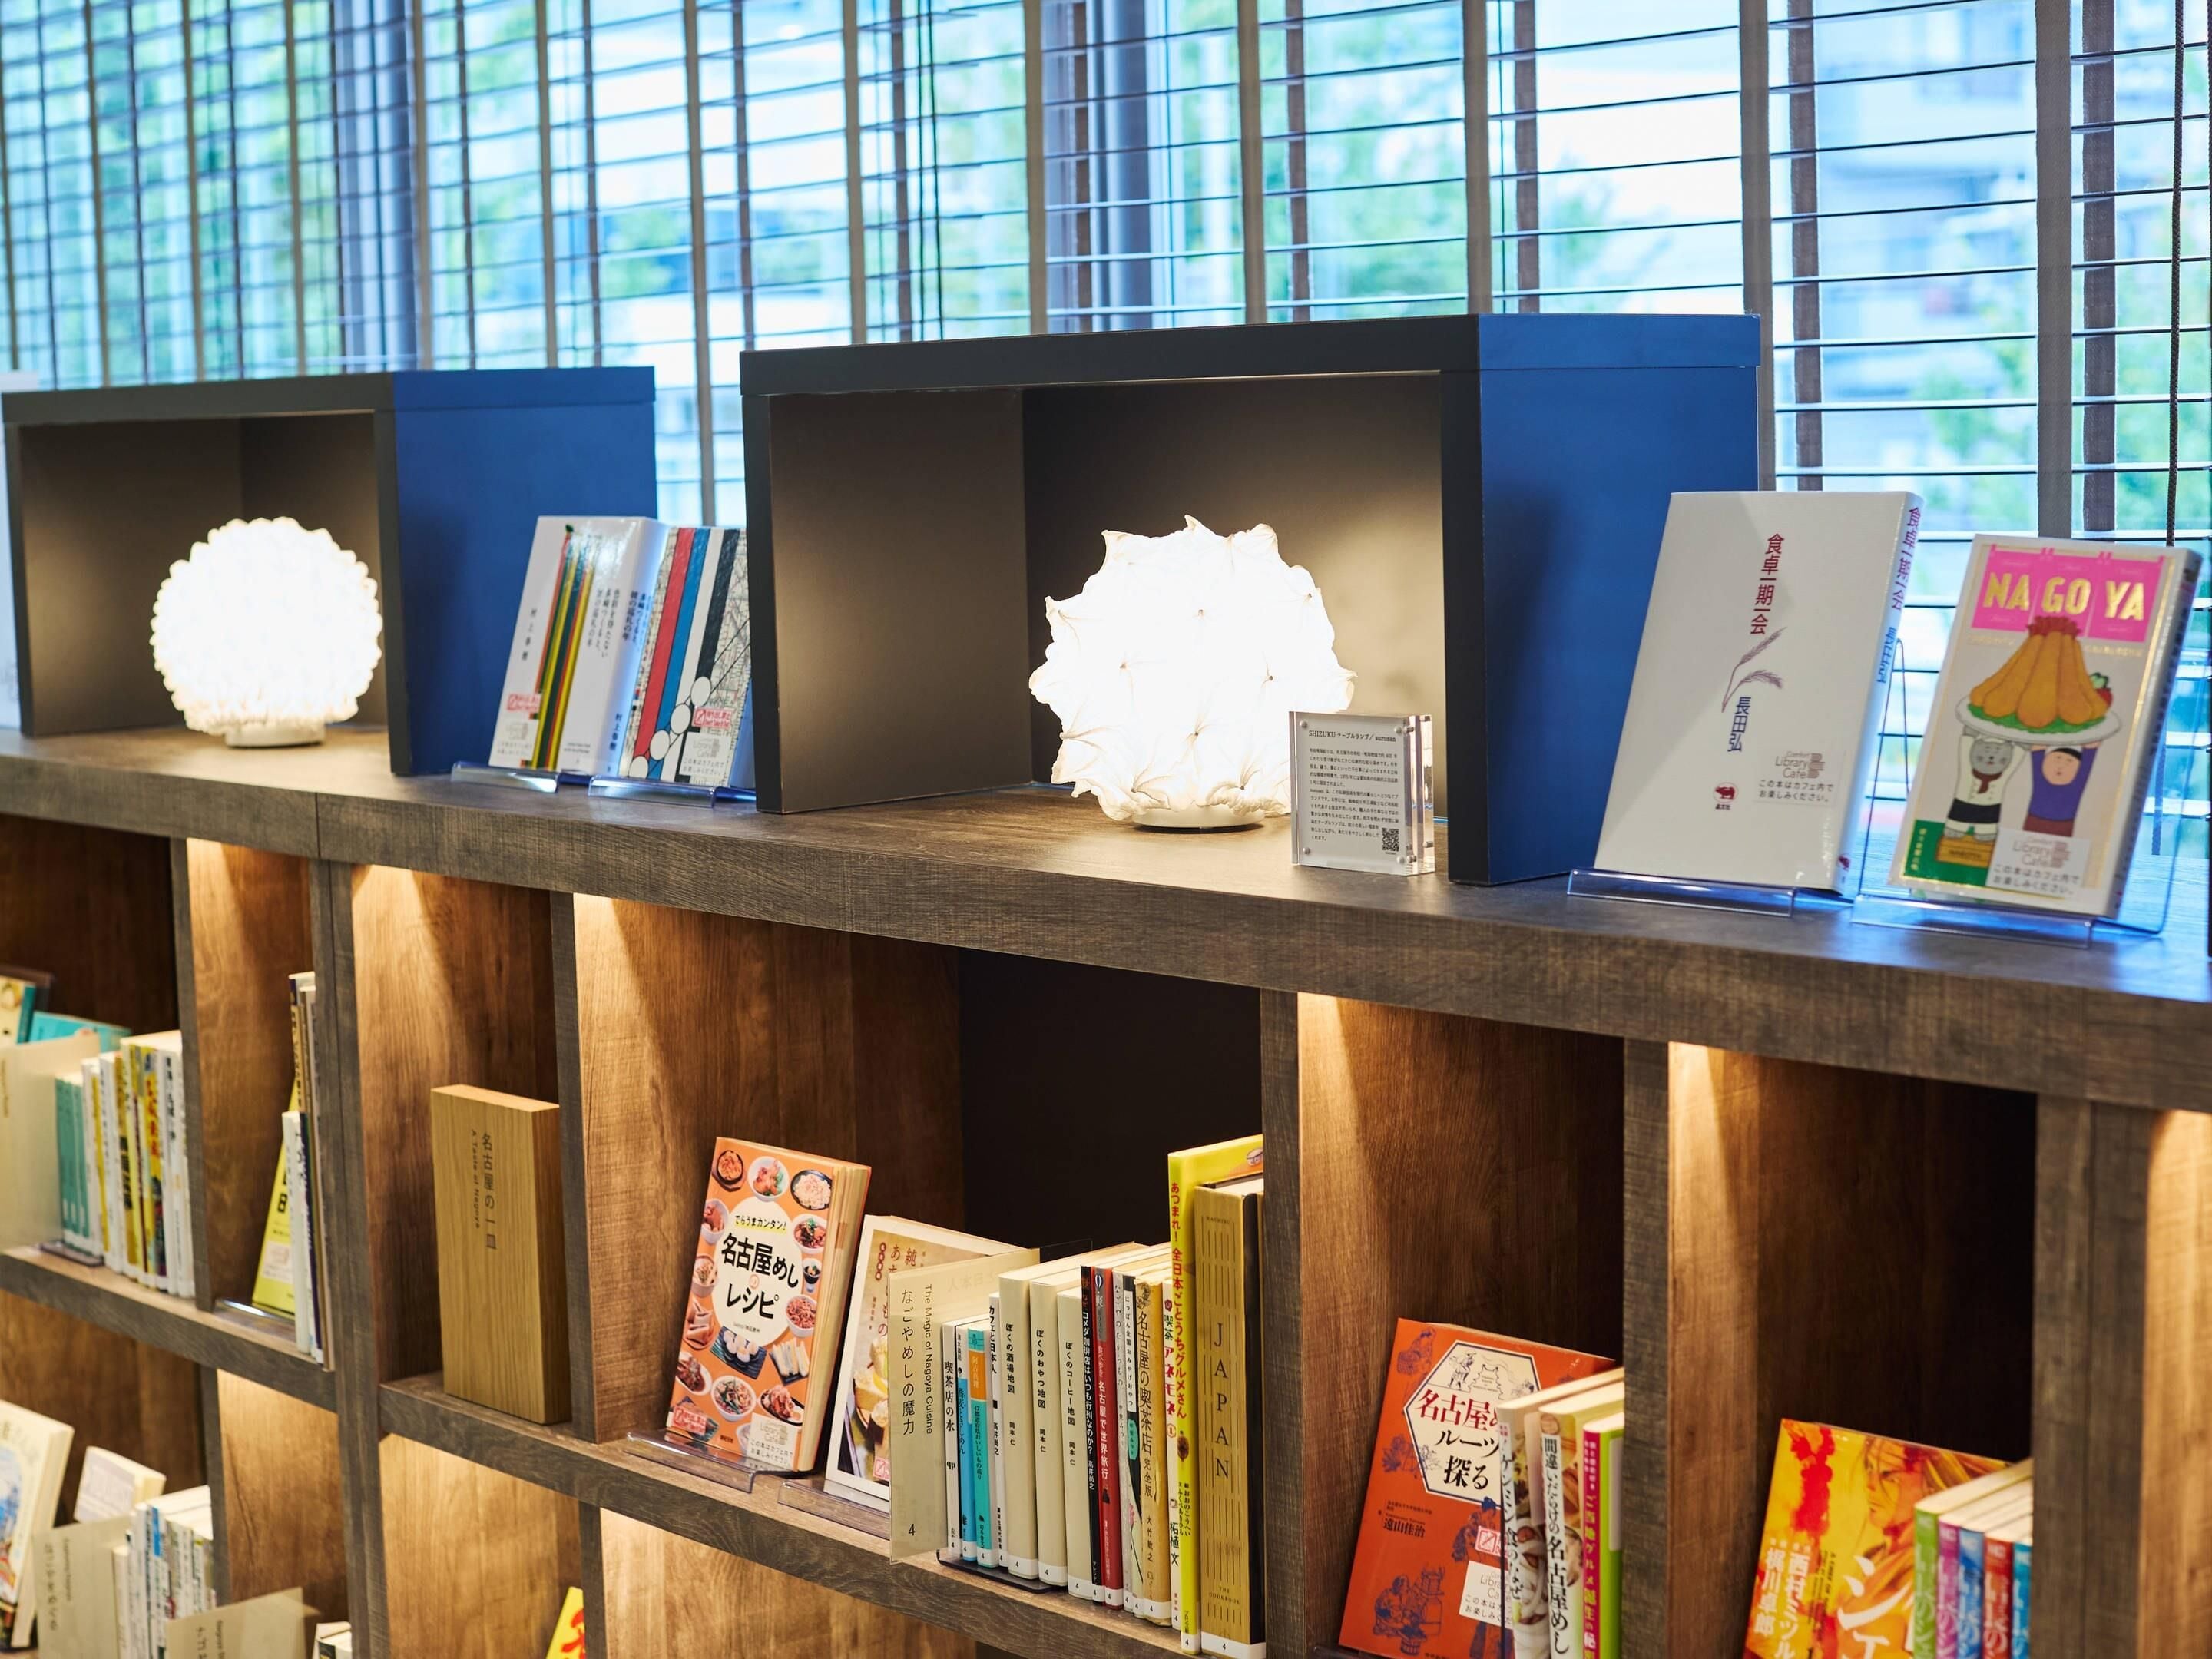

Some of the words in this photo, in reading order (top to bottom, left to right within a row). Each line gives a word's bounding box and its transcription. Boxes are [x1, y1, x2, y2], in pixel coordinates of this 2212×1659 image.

[1750, 533, 1785, 635] 食卓一期一会
[1892, 507, 1921, 611] 食卓一期一会
[1982, 572, 2030, 611] NA
[2041, 576, 2091, 615] GO
[2104, 580, 2145, 621] YA
[1726, 697, 1752, 753] 長田弘
[1758, 780, 1834, 792] この本はカフェ内で
[1775, 756, 1808, 770] Library
[1758, 790, 1830, 803] お楽しみください。
[1993, 864, 2080, 885] この本はカフェ内で
[1171, 1182, 1181, 1242] あつまれ!
[721, 1233, 799, 1288] 名古屋めし
[727, 1283, 780, 1320] レシピ
[923, 1307, 932, 1338] Magic
[925, 1341, 933, 1351] of
[989, 1306, 998, 1374] カフェと日本人
[1005, 1323, 1015, 1394] ぼくの酒場地図
[1172, 1247, 1187, 1419] 全日本ごとうちグルメさん
[902, 1290, 916, 1435] なごやめしの魔力
[924, 1354, 933, 1393] Nagoya
[1036, 1330, 1046, 1409] ぼくのおやつ地図
[1065, 1342, 1075, 1426] ぼくのコーヒー地図
[1082, 1312, 1094, 1454] コメダ珈琲店はいつも行列なのか?
[1137, 1311, 1152, 1456] 名古屋の喫茶店
[945, 1361, 955, 1432] 喫茶店の水
[1214, 1323, 1230, 1479] JAPAN
[1098, 1382, 1110, 1480] 名古屋で世界旅行
[1143, 1457, 1153, 1498] 完全版
[1443, 1455, 1489, 1490] 探る
[909, 1523, 916, 1536] 4
[1171, 1519, 1179, 1566] 柘植文
[1544, 1436, 1570, 1654] 間違いだらけの名古屋めし
